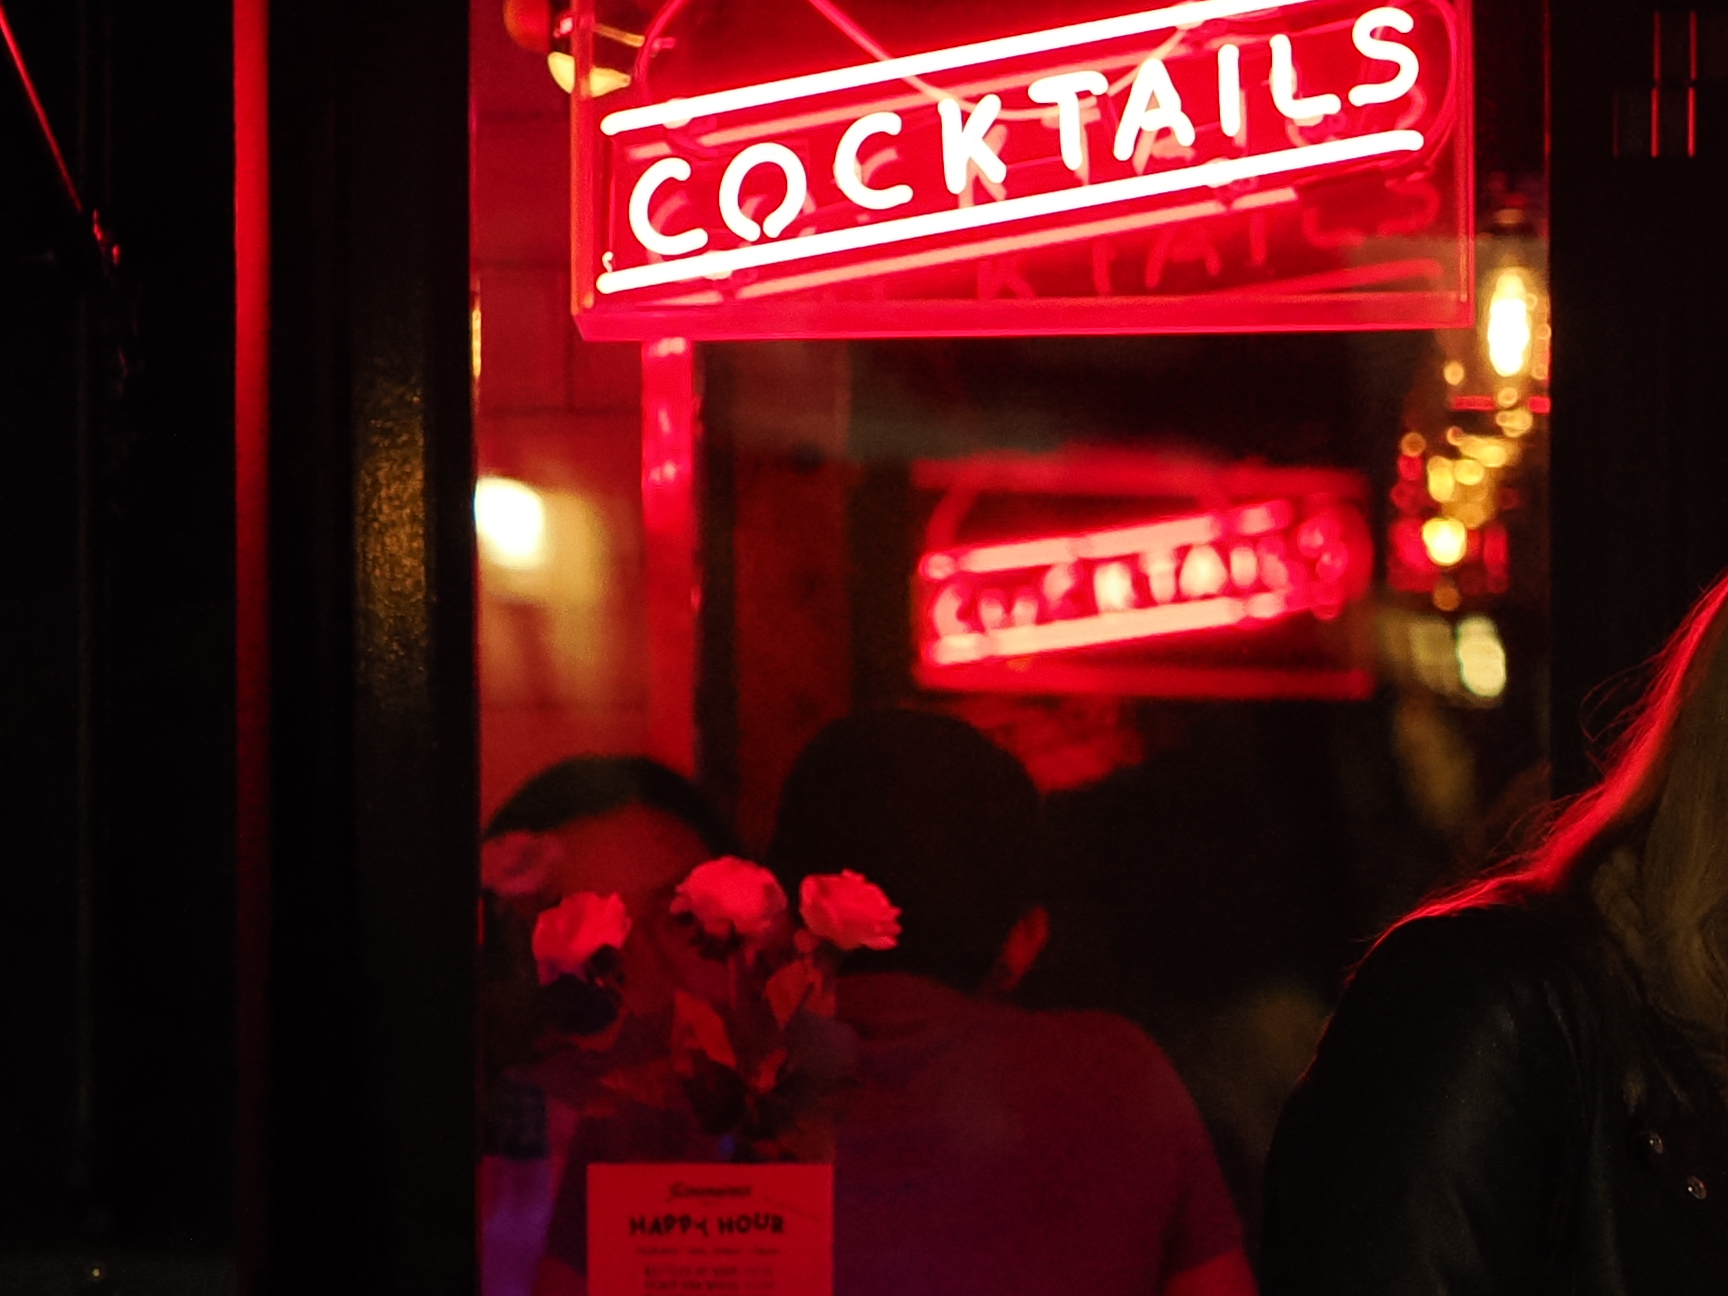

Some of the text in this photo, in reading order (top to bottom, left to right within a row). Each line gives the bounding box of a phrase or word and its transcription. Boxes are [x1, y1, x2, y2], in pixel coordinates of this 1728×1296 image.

[629, 6, 1419, 255] COCKTAILS
[629, 1212, 784, 1236] HAPPY HOUR
